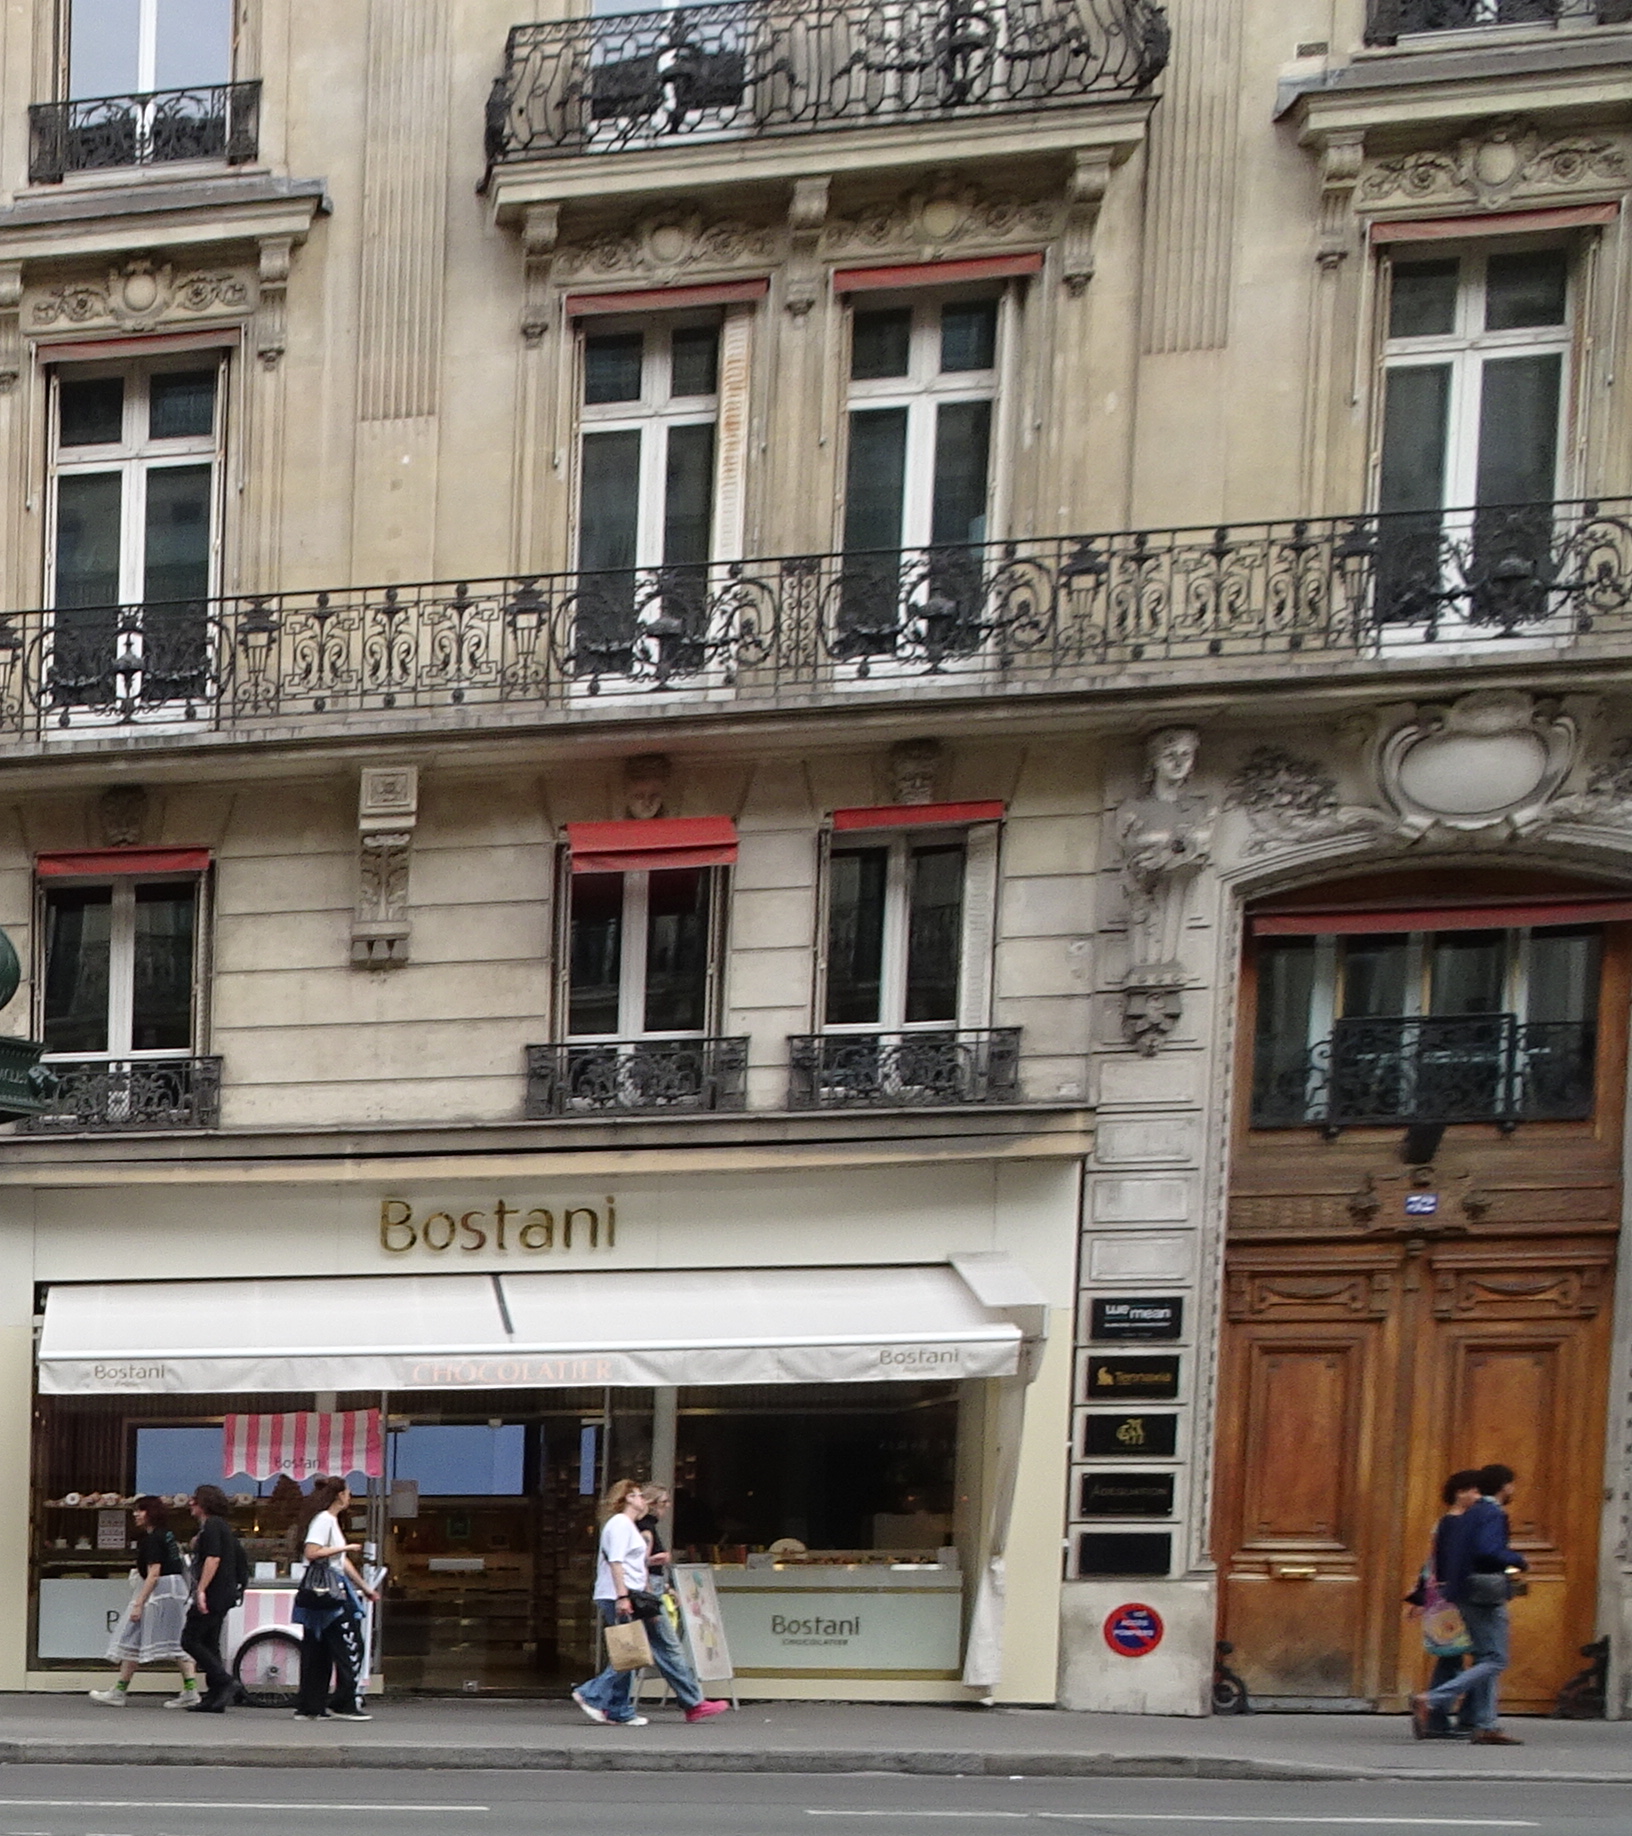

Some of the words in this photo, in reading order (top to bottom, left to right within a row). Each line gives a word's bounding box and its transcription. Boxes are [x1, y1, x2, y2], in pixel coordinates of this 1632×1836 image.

[380, 1196, 616, 1252] Bostani
[879, 1348, 960, 1366] Bostani
[94, 1364, 166, 1380] Bostani
[412, 1360, 613, 1384] CHOCOLATIER
[772, 1614, 860, 1635] Bostani
